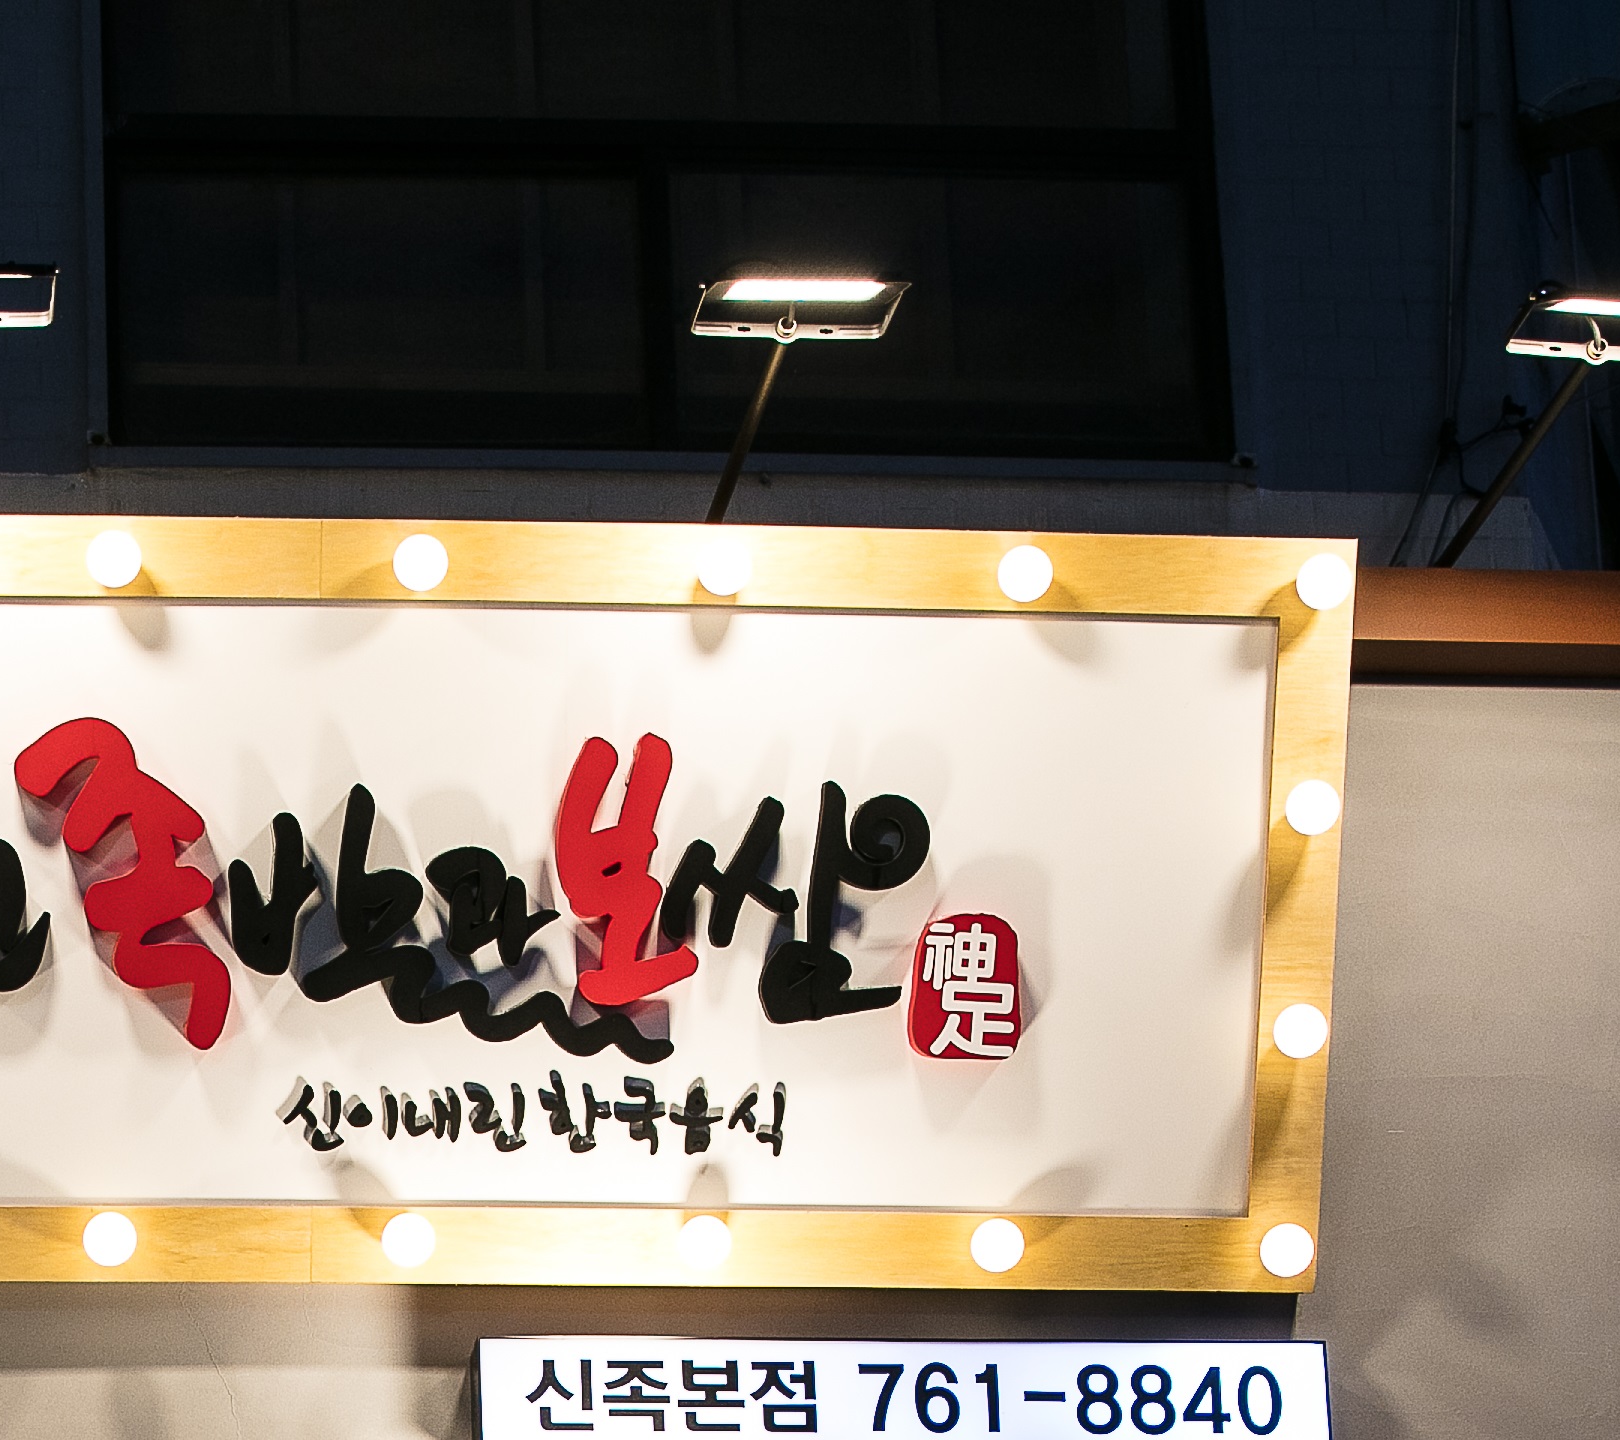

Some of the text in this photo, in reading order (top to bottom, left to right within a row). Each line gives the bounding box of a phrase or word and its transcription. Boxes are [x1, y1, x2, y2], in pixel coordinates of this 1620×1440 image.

[285, 1071, 787, 1157] 신이내린 한국음식
[524, 1358, 1283, 1437] 신족본점 761-8840
